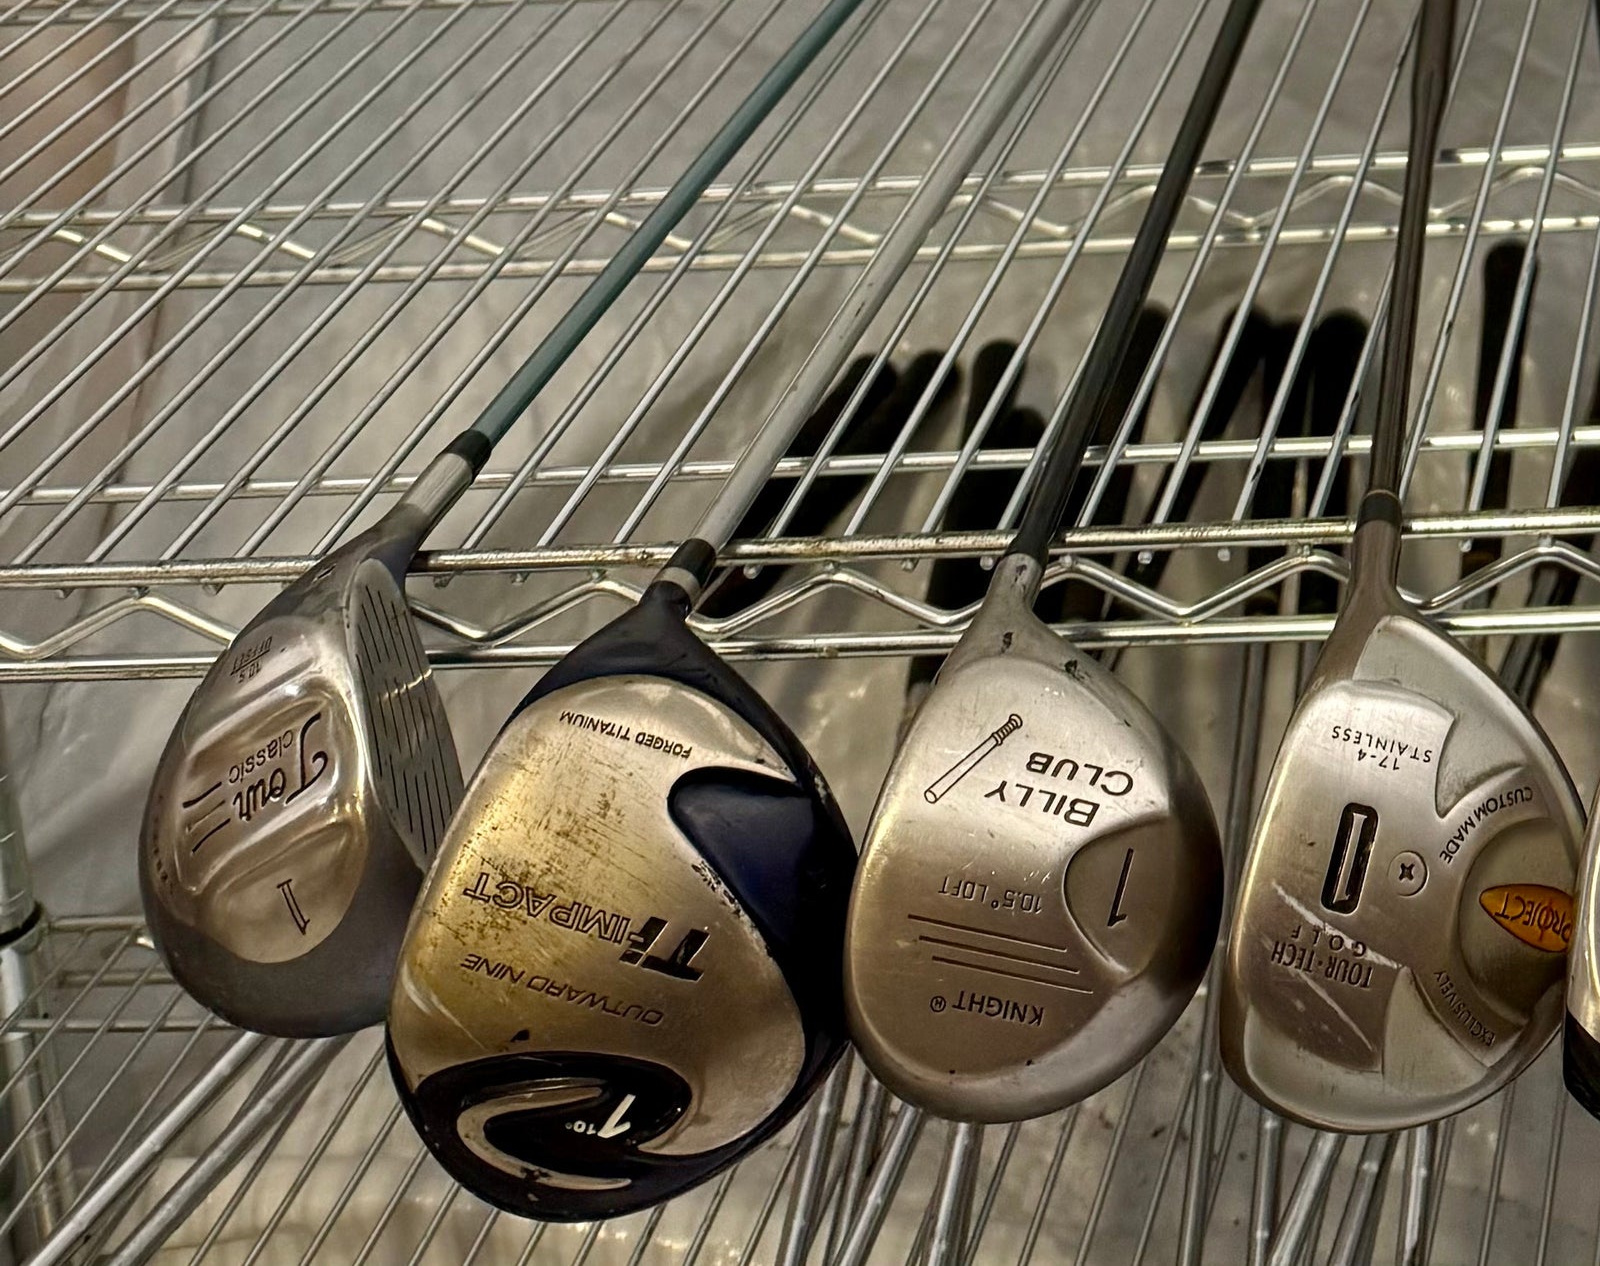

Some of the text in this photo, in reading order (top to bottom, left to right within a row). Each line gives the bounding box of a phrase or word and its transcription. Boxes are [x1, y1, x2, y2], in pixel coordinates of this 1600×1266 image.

[228, 727, 293, 785] classic
[559, 710, 693, 759] FORGED TITANIUM
[1330, 723, 1433, 764] STAINLESS
[233, 712, 329, 820] Tour
[1024, 750, 1134, 796] CLUB
[1356, 748, 1401, 771] 17-4
[983, 779, 1101, 828] BILLY
[1439, 785, 1534, 865] CUSTOM MADE
[276, 879, 311, 936] 1
[937, 874, 988, 904] LOFT
[1106, 847, 1134, 928] 1
[1288, 924, 1368, 958] GOLF
[460, 951, 664, 1027] OUTWARD NINE
[951, 989, 1045, 1027] KNIGHT
[1433, 970, 1496, 1047] EXCLUSIVELY
[599, 1094, 636, 1140] 1
